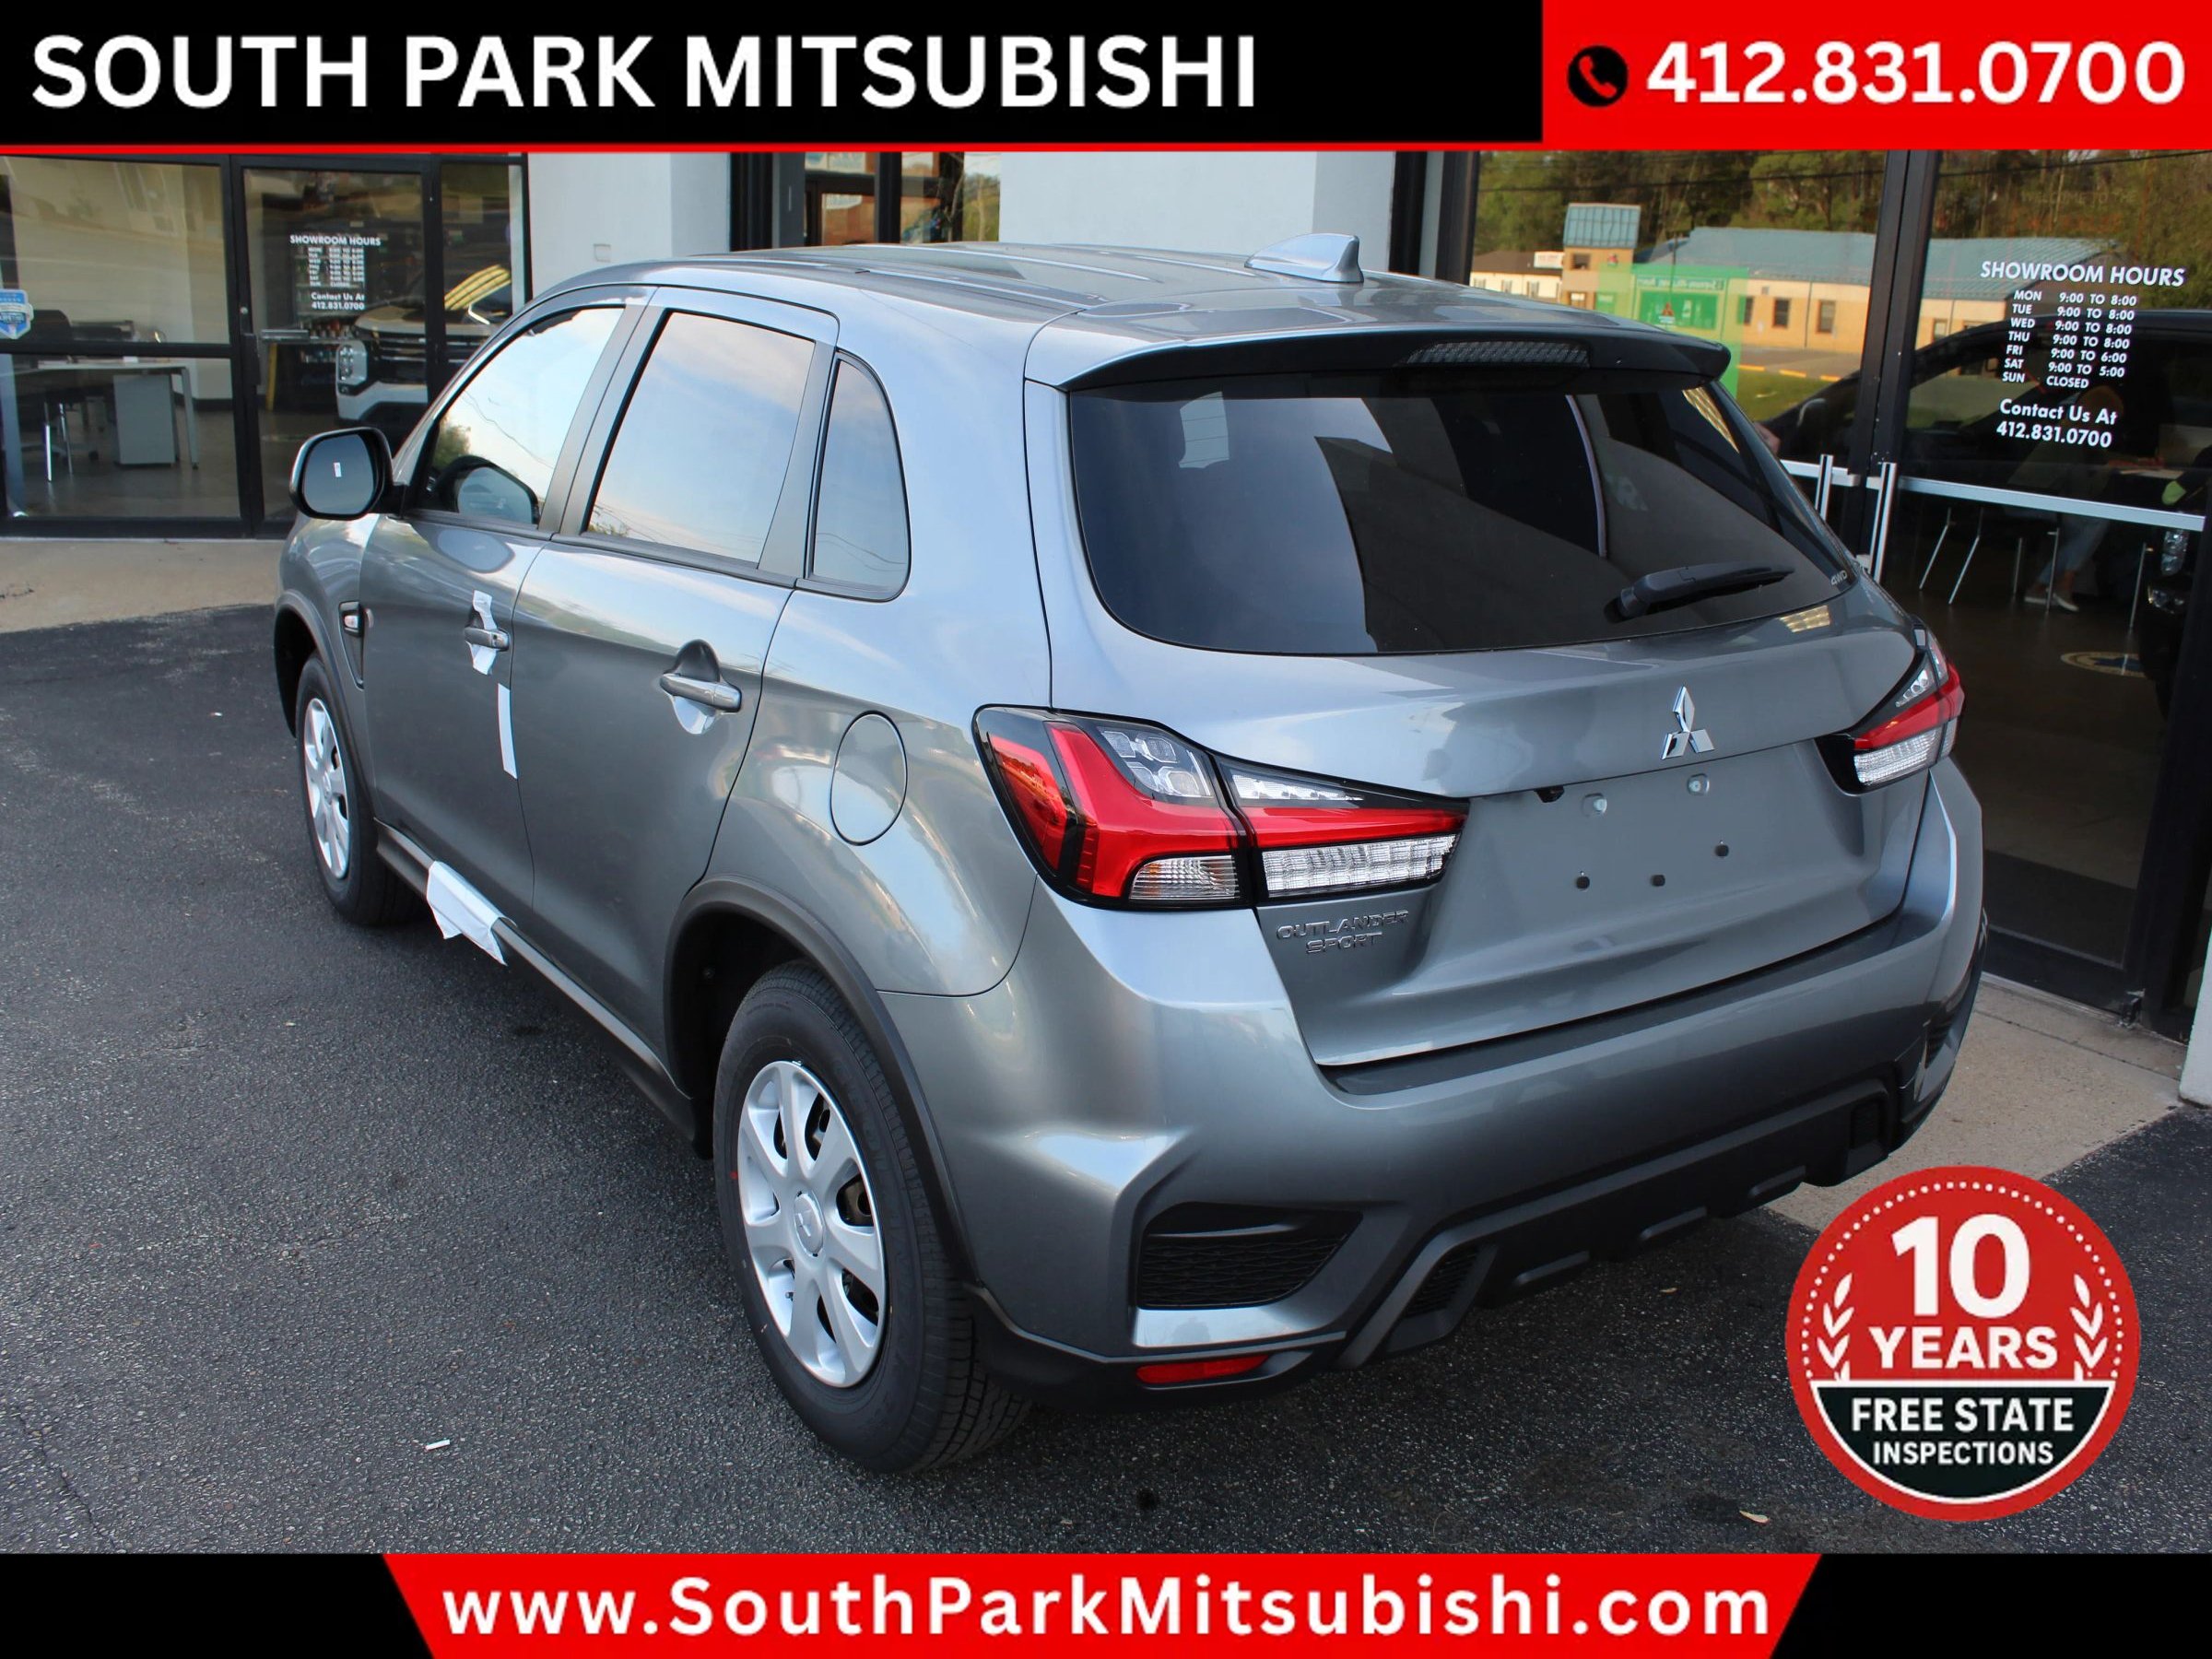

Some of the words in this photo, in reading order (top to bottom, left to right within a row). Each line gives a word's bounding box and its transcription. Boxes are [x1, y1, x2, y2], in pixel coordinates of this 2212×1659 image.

[289, 234, 347, 245] SHOWROOM
[348, 237, 382, 246] HOURS
[1981, 261, 2103, 284] SHOWROOM
[2109, 266, 2186, 287] HOURS
[311, 291, 342, 300] Contact
[2013, 290, 2042, 301] MON
[2059, 292, 2084, 303] 9:00
[2089, 293, 2105, 304] TO
[2110, 295, 2137, 307] 8:00
[2012, 304, 2032, 315] TUE
[2057, 306, 2080, 318] 9:00
[2087, 308, 2102, 319] TO
[2108, 310, 2135, 321] 8:00
[2010, 317, 2036, 328] WED
[2054, 320, 2079, 332] 9:00
[2085, 322, 2100, 333] TO
[2105, 324, 2132, 335] 8:00
[2008, 331, 2030, 342] THU
[2052, 334, 2077, 346] 9:00
[2083, 335, 2099, 347] TO
[2103, 337, 2130, 349] 8:00
[2006, 345, 2023, 356] FRI
[2050, 348, 2075, 359] 9:00
[2080, 350, 2096, 361] TO
[2100, 351, 2127, 364] 6:00
[2004, 358, 2024, 370] SAT
[2048, 361, 2072, 373] 9:00
[2077, 364, 2092, 375] TO
[2099, 366, 2125, 378] 5:00
[2002, 371, 2025, 383] SUN
[2046, 375, 2089, 389] CLOSED
[1999, 399, 2064, 420] Contact
[2068, 406, 2090, 422] Us
[2095, 408, 2117, 425] At
[1996, 420, 2112, 448] 412.831.0700
[1830, 570, 1848, 585] 4WD
[1277, 910, 1409, 940] OUTLANDER
[1306, 932, 1382, 954] SPORT
